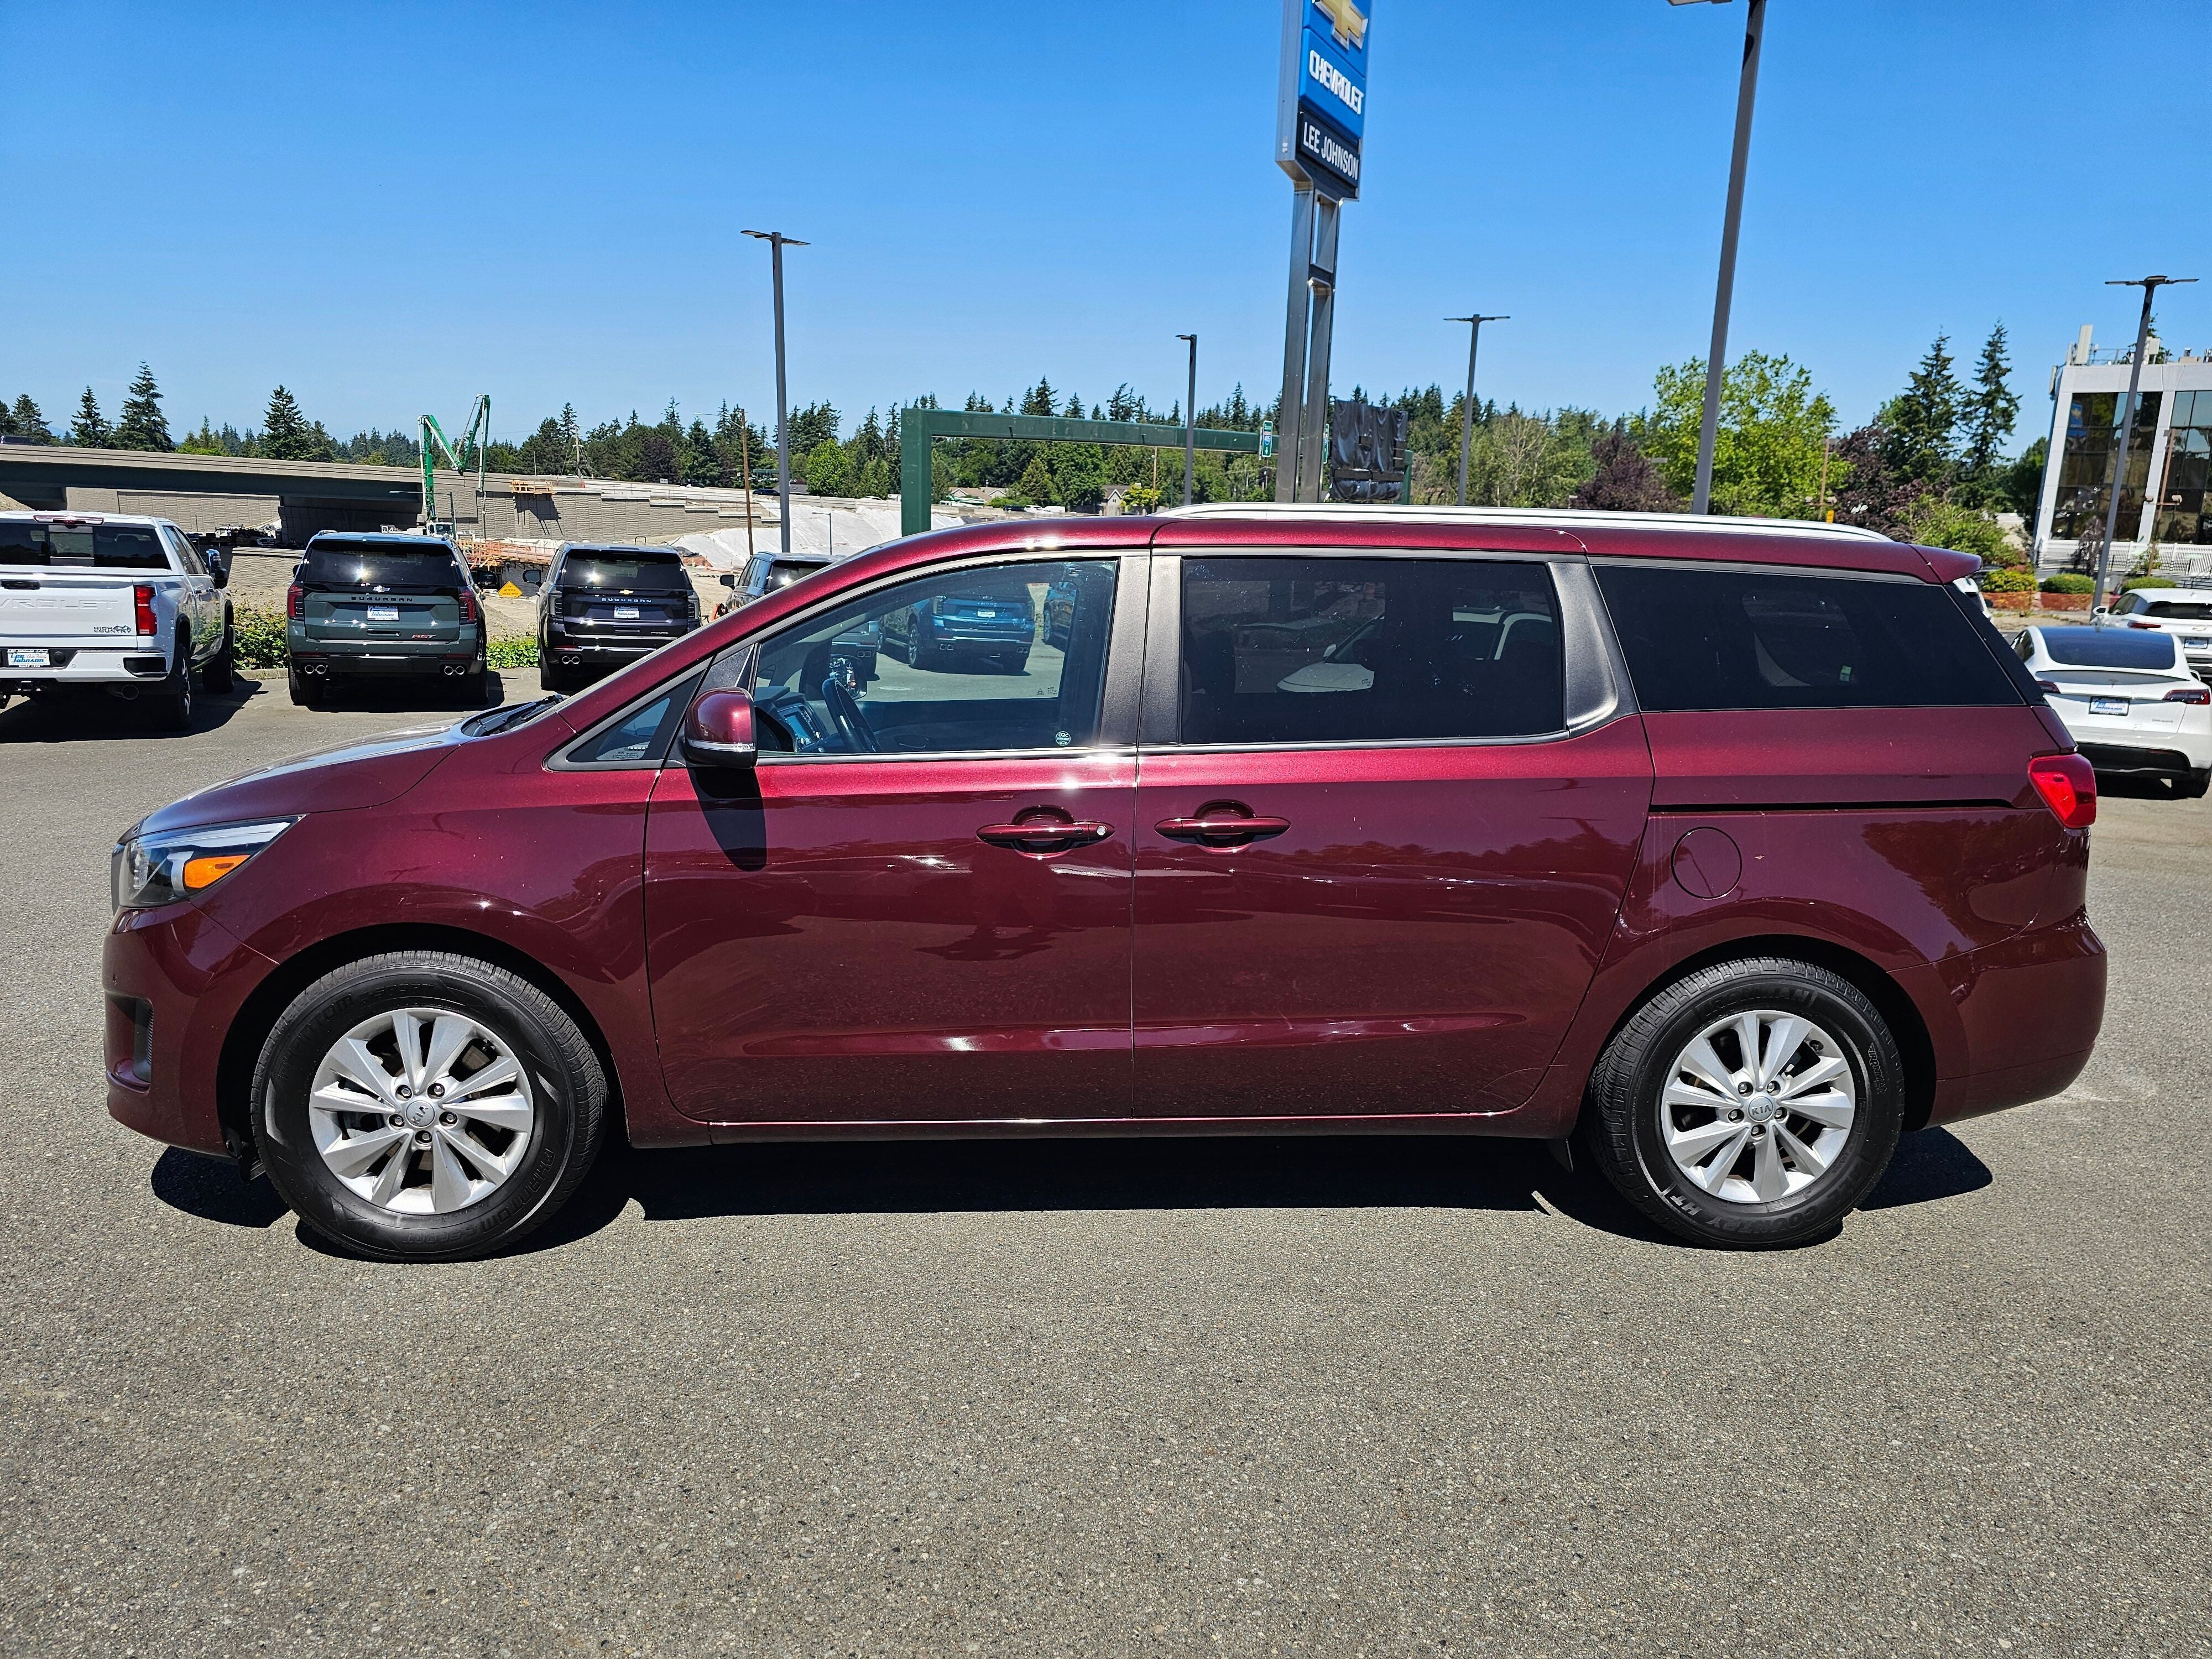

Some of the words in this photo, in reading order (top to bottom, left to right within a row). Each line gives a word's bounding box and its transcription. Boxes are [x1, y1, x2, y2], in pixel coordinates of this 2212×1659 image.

[1309, 50, 1364, 114] CHEVROLET
[1303, 122, 1321, 154] LEE
[1321, 137, 1359, 180] JOHNSON
[410, 1106, 429, 1125] KIA
[1751, 1104, 1771, 1115] KIA
[480, 1148, 556, 1234] PHANTOM
[1670, 1195, 1703, 1216] HT
